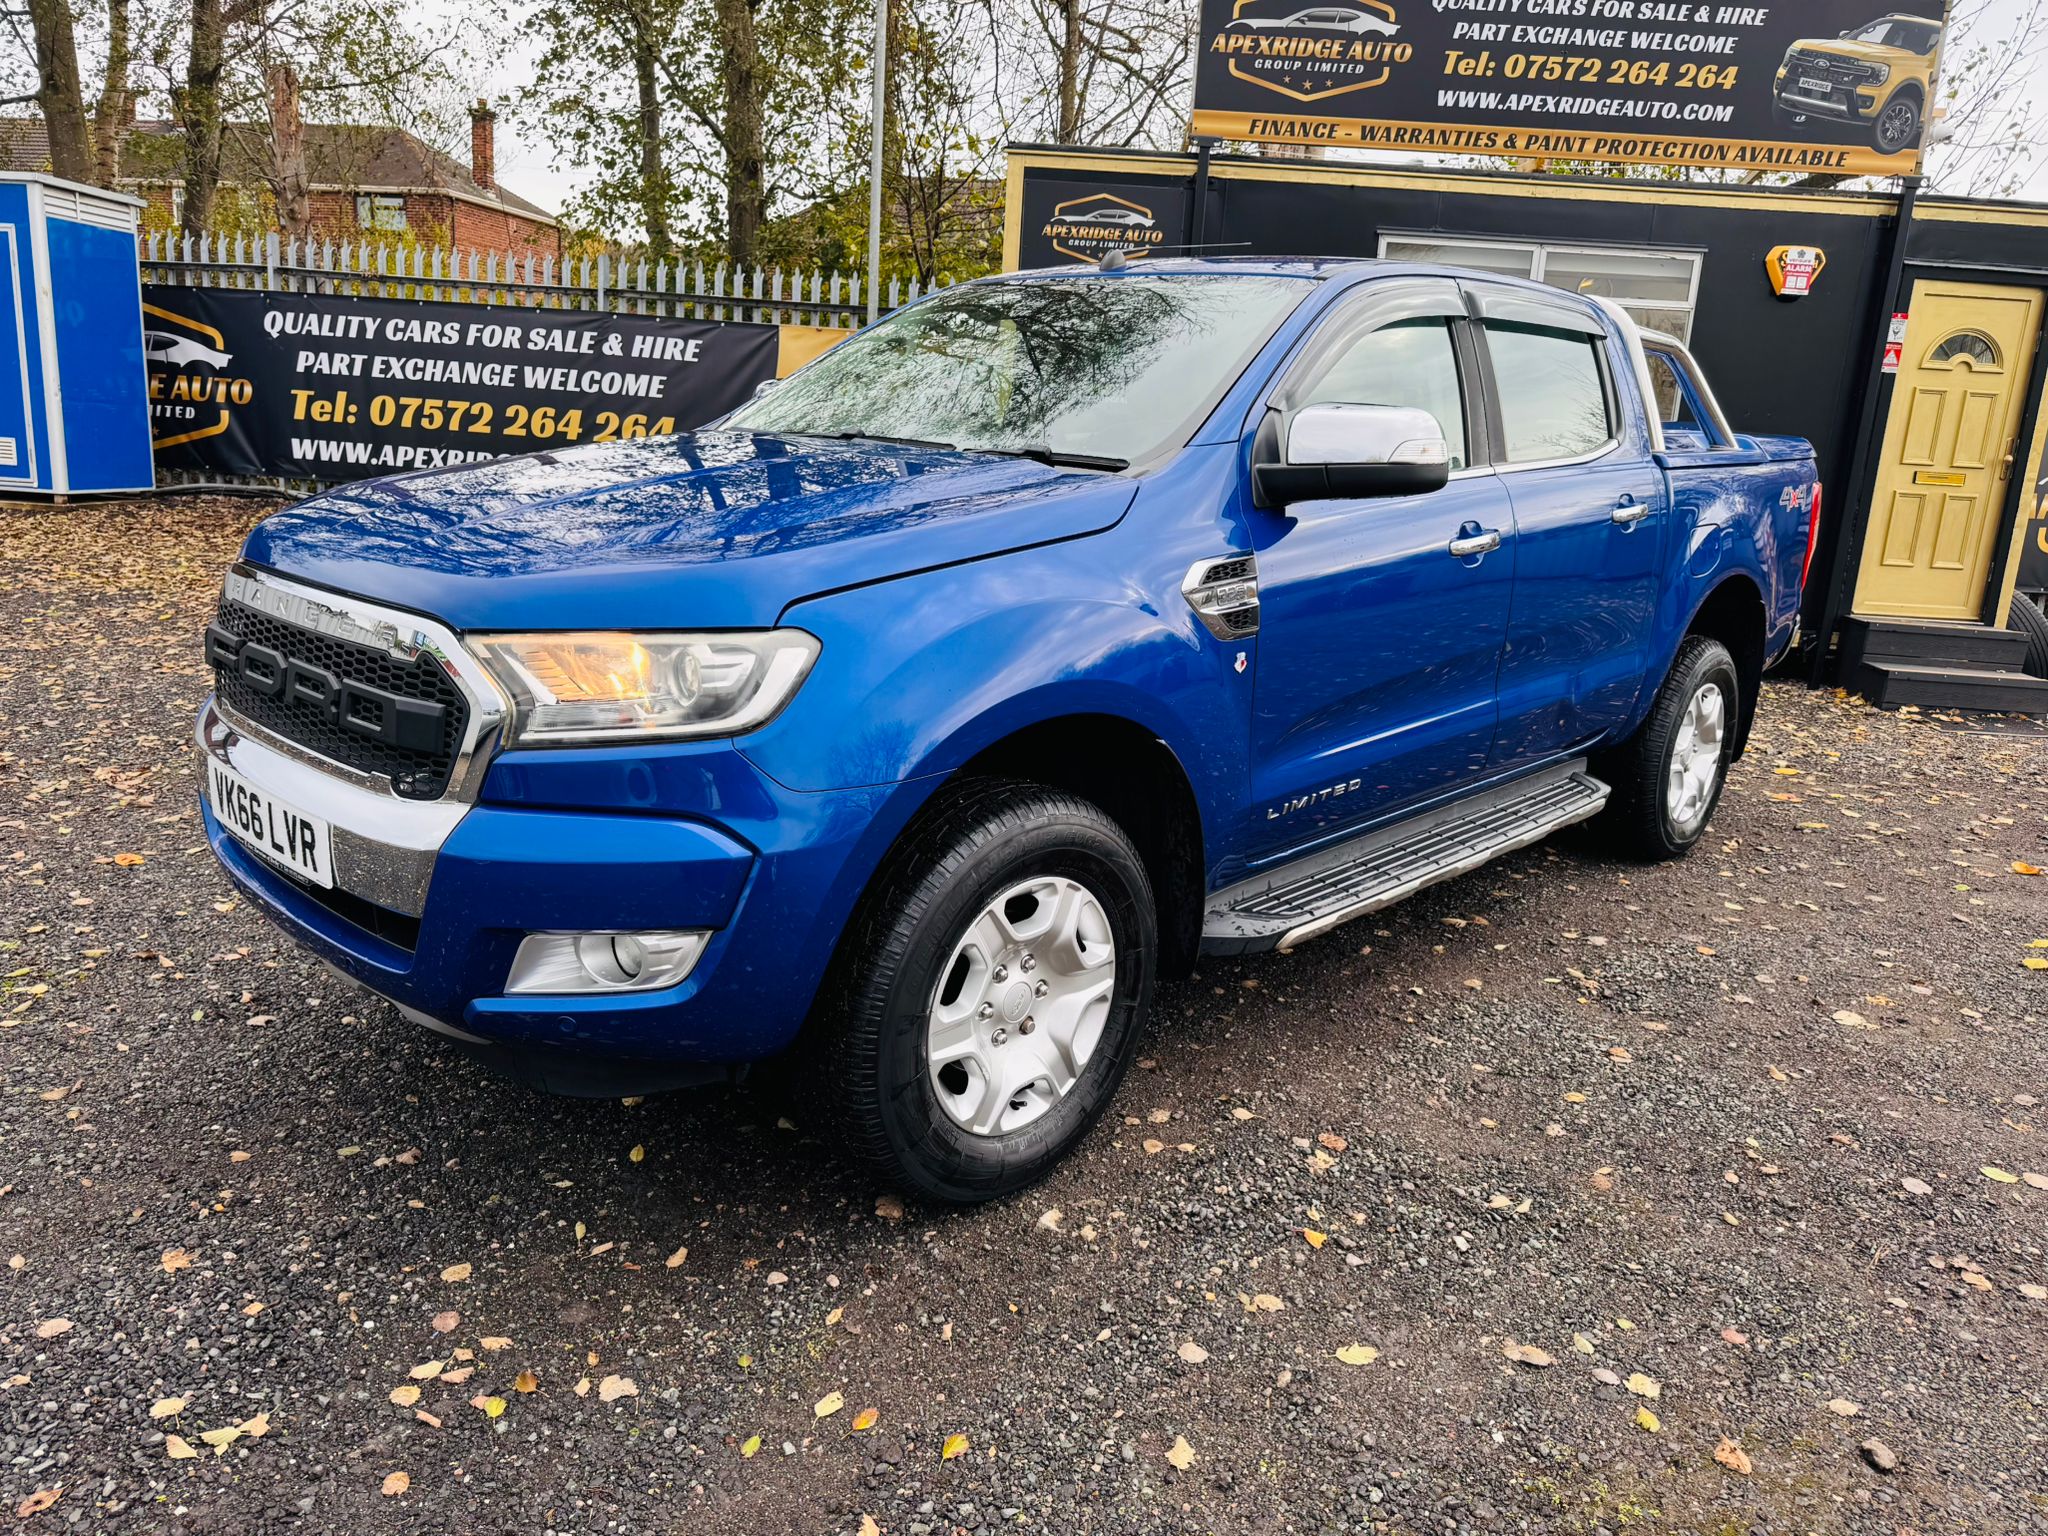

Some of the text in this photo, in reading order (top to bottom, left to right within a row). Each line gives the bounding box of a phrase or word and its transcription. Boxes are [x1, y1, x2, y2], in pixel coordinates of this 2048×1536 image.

[1527, 0, 1586, 16] CARS
[1591, 0, 1635, 19] FOR
[1637, 2, 1692, 22] SALE
[1694, 5, 1711, 23] &
[1715, 6, 1769, 26] HIRE
[1210, 33, 1413, 63] APEXRIDGE AUTO
[1452, 21, 1739, 54] PART EXCHANGE WELCOME
[1254, 58, 1365, 74] GROUP LIMITED
[1443, 50, 1739, 90] Tel: 07572 264 264
[1437, 89, 1735, 122] WWW.APEXRIDGEAUTO.COM
[1248, 118, 1340, 139] FINANCE
[1360, 124, 1499, 148] WARRANTIES
[1503, 132, 1518, 150] &
[1524, 133, 1591, 153] PAINT
[1593, 137, 1732, 161] PROTECTION
[1733, 145, 1850, 168] AVAILABLE
[1042, 223, 1164, 243] APEXRIDGE AUTO
[1068, 239, 1135, 250] GROUP LIMITED
[1786, 264, 1812, 273] ALARM
[263, 310, 704, 363] QUALITY CARS FOR SALE & HIRE
[170, 374, 253, 405] AUTO
[296, 350, 668, 399] PART EXCHANGE WELCOME
[290, 389, 676, 442] Tel: 07572 264 264
[231, 578, 398, 648] RANGER
[1267, 778, 1362, 820] LIMITED
[214, 767, 264, 841] VK66
[267, 801, 318, 874] LVR
